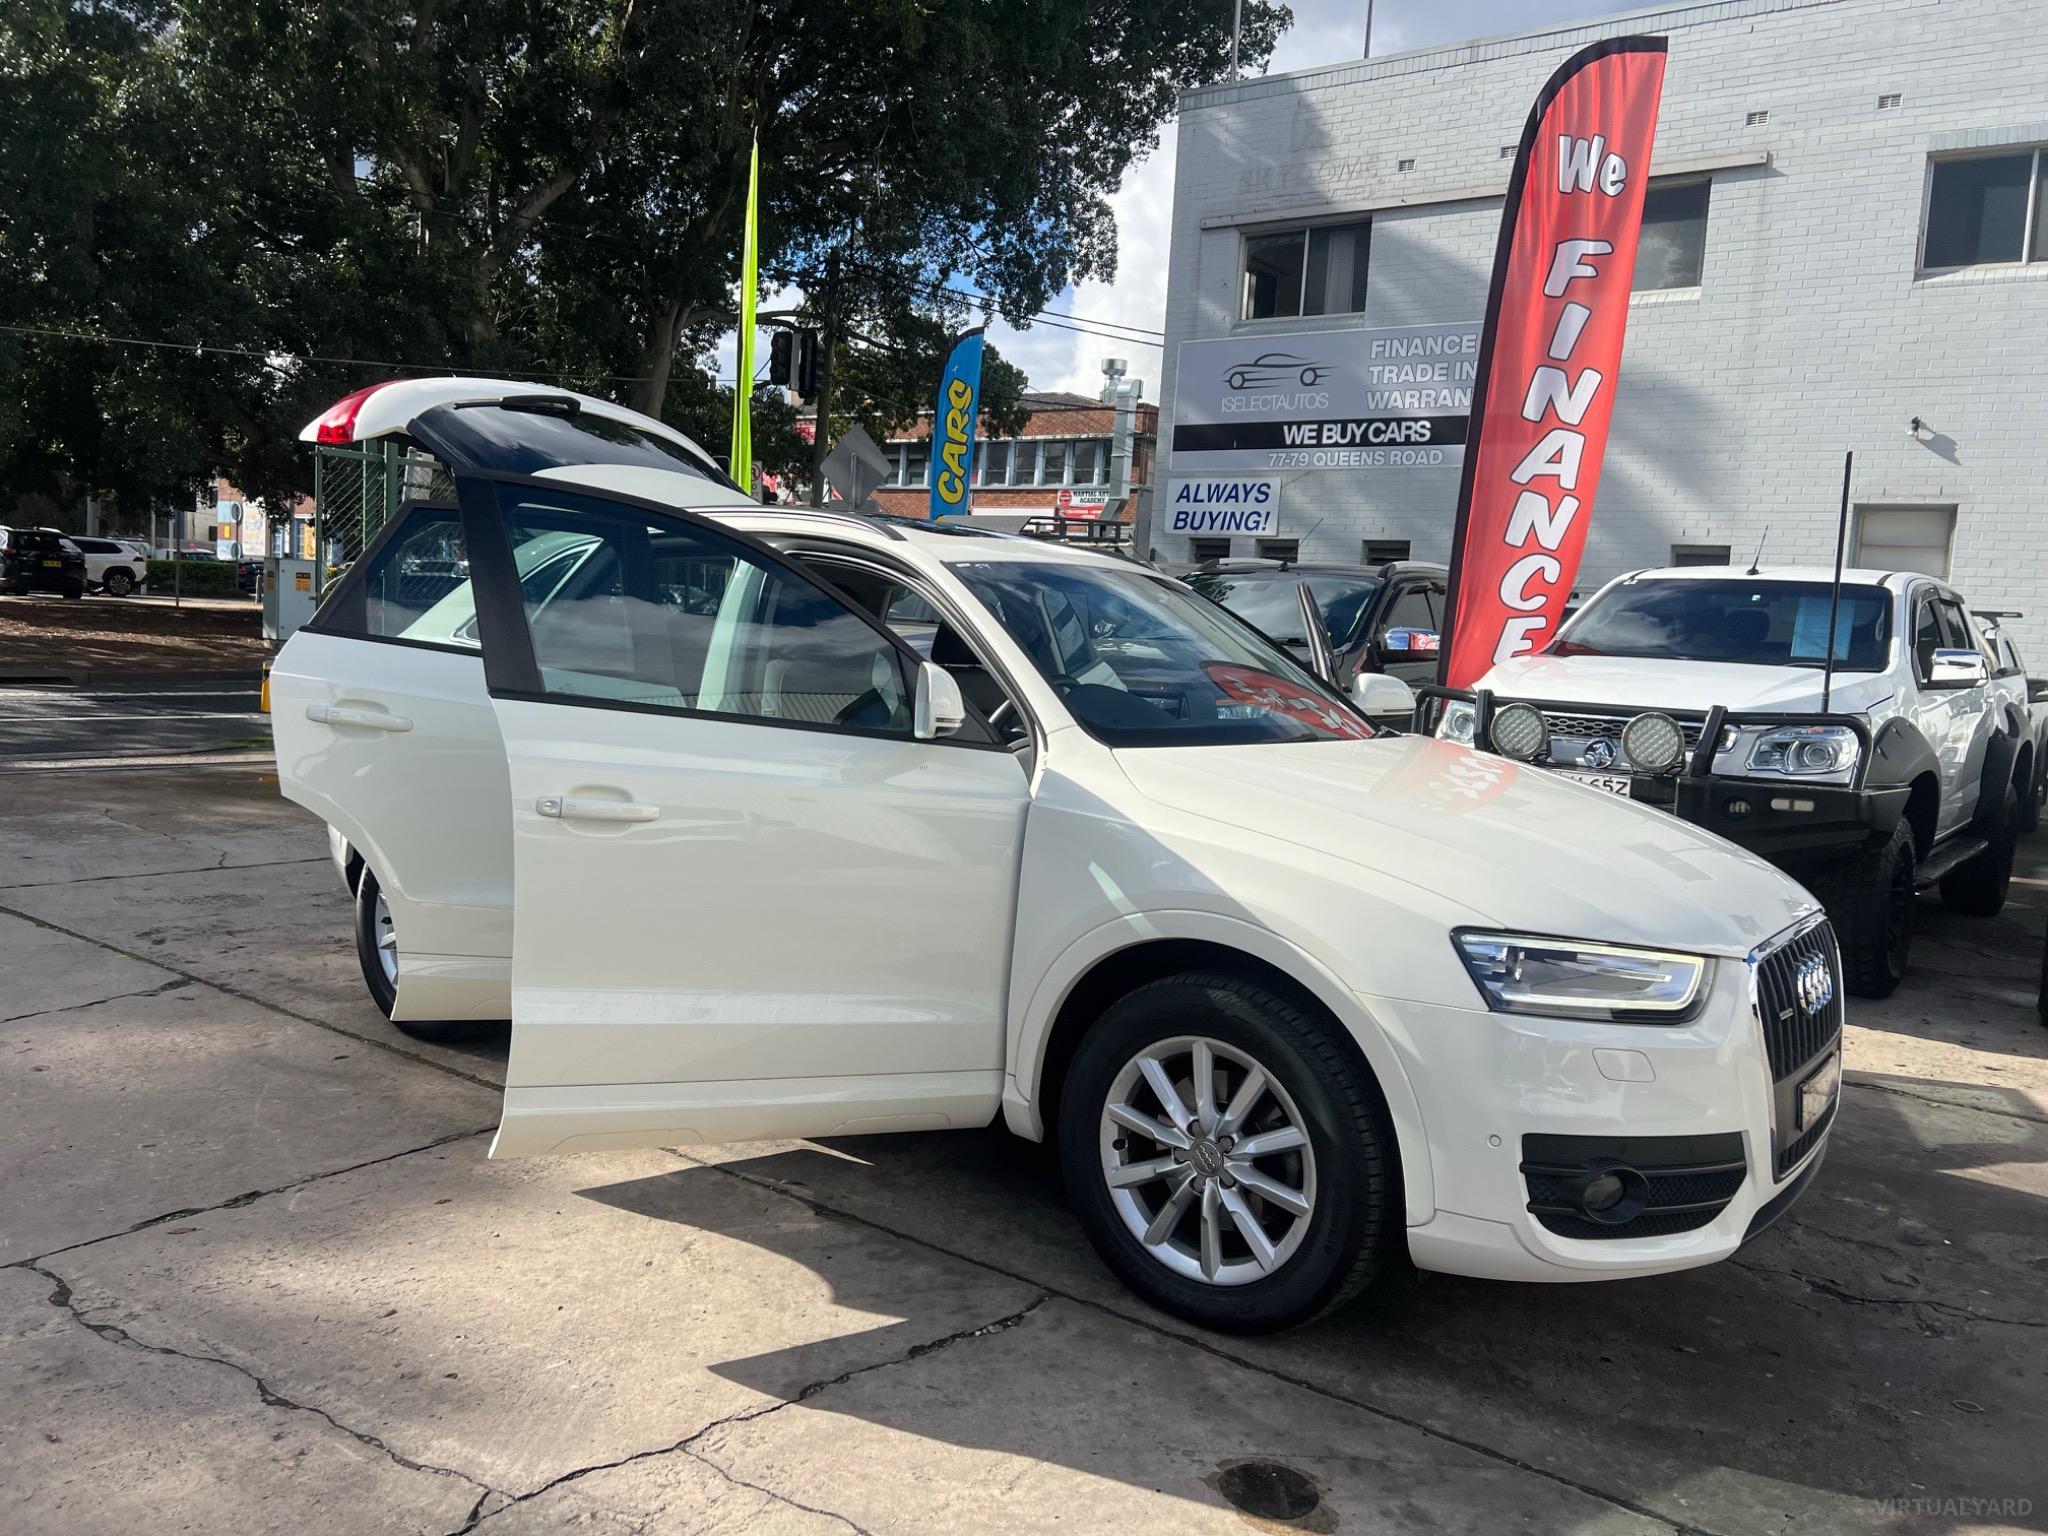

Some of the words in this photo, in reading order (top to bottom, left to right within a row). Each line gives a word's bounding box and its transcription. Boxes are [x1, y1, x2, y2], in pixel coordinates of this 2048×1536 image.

[1557, 133, 1627, 197] We
[1369, 333, 1477, 359] FINANCE
[1367, 362, 1448, 384] TRADE
[1453, 359, 1478, 381] IN
[1365, 386, 1472, 410] WARRAN
[937, 379, 973, 504] CARS
[1283, 423, 1318, 445] WE
[1321, 421, 1368, 444] BUY
[1367, 420, 1431, 443] CARS
[1267, 450, 1309, 467] 77-79
[1312, 450, 1385, 467] QUEENS
[1388, 448, 1443, 466] ROAD
[1491, 237, 1614, 666] FINANCE
[1174, 482, 1272, 504] ALWAYS
[1172, 510, 1271, 532] BUYING!
